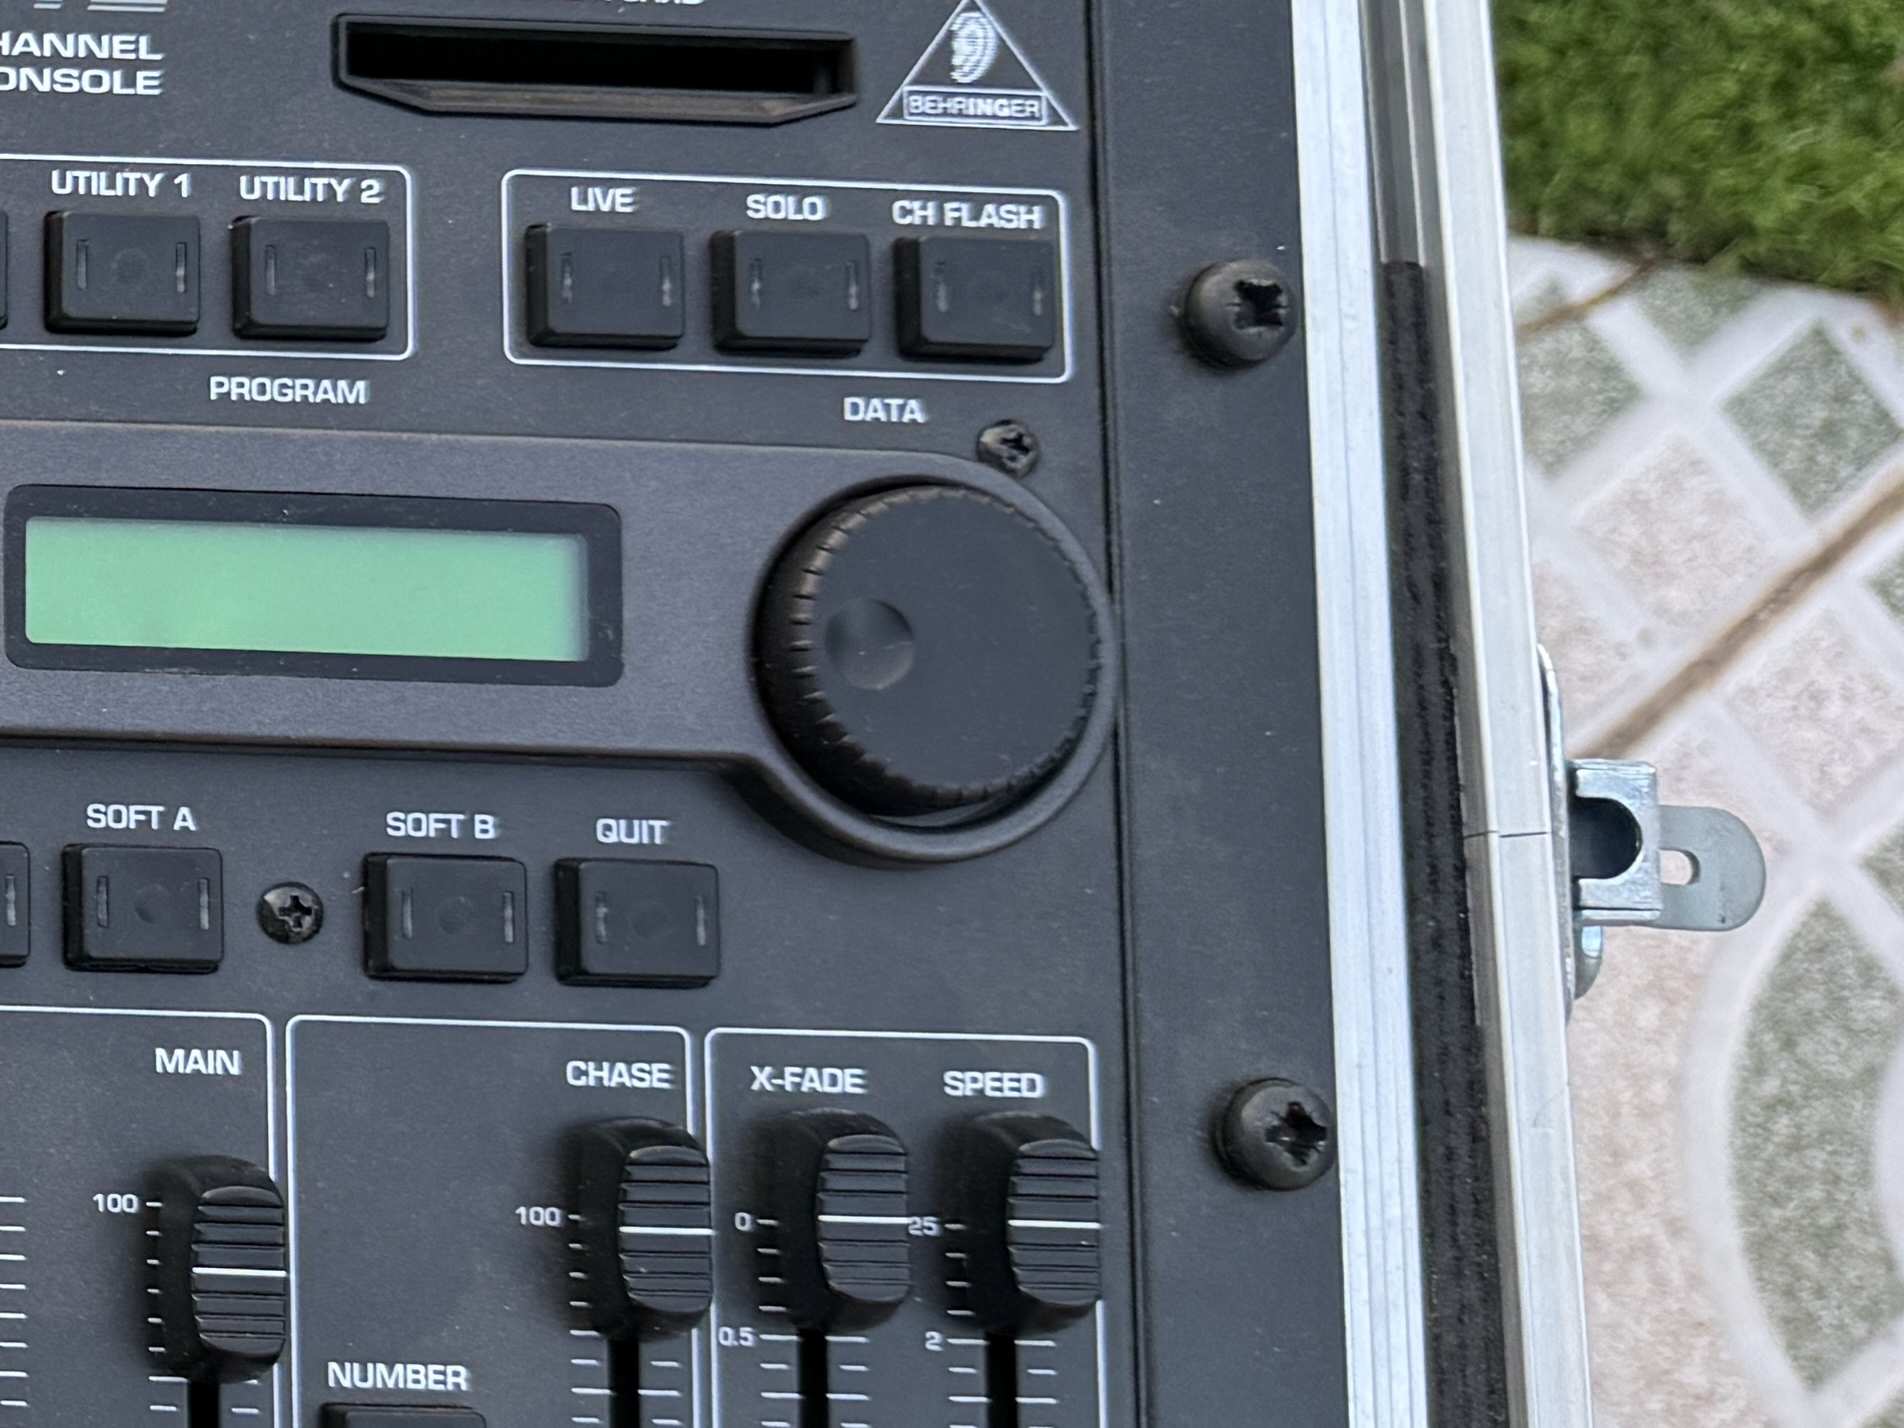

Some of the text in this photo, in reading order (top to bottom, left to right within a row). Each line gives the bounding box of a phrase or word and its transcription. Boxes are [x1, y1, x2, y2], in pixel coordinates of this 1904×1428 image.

[908, 94, 1041, 118] BEHRINGER
[51, 170, 189, 198] UTILITY 1
[239, 175, 381, 204] UTILITY 2
[571, 187, 633, 213] LIVE
[747, 194, 825, 221] SOLO
[892, 200, 1042, 229] CH FLASH
[210, 376, 366, 404] PROGRAM
[844, 397, 925, 423] DATA
[87, 803, 197, 831] SOFT A
[386, 811, 495, 839] SOFT B
[596, 818, 669, 845] QUIT
[155, 1047, 240, 1075] MAIN
[566, 1061, 670, 1088] CHASE
[751, 1066, 864, 1094] X-FADE
[944, 1071, 1043, 1098] SPEED
[718, 1326, 756, 1347] 0.5
[925, 1331, 942, 1351] 2
[328, 1362, 468, 1391] NUMBER
